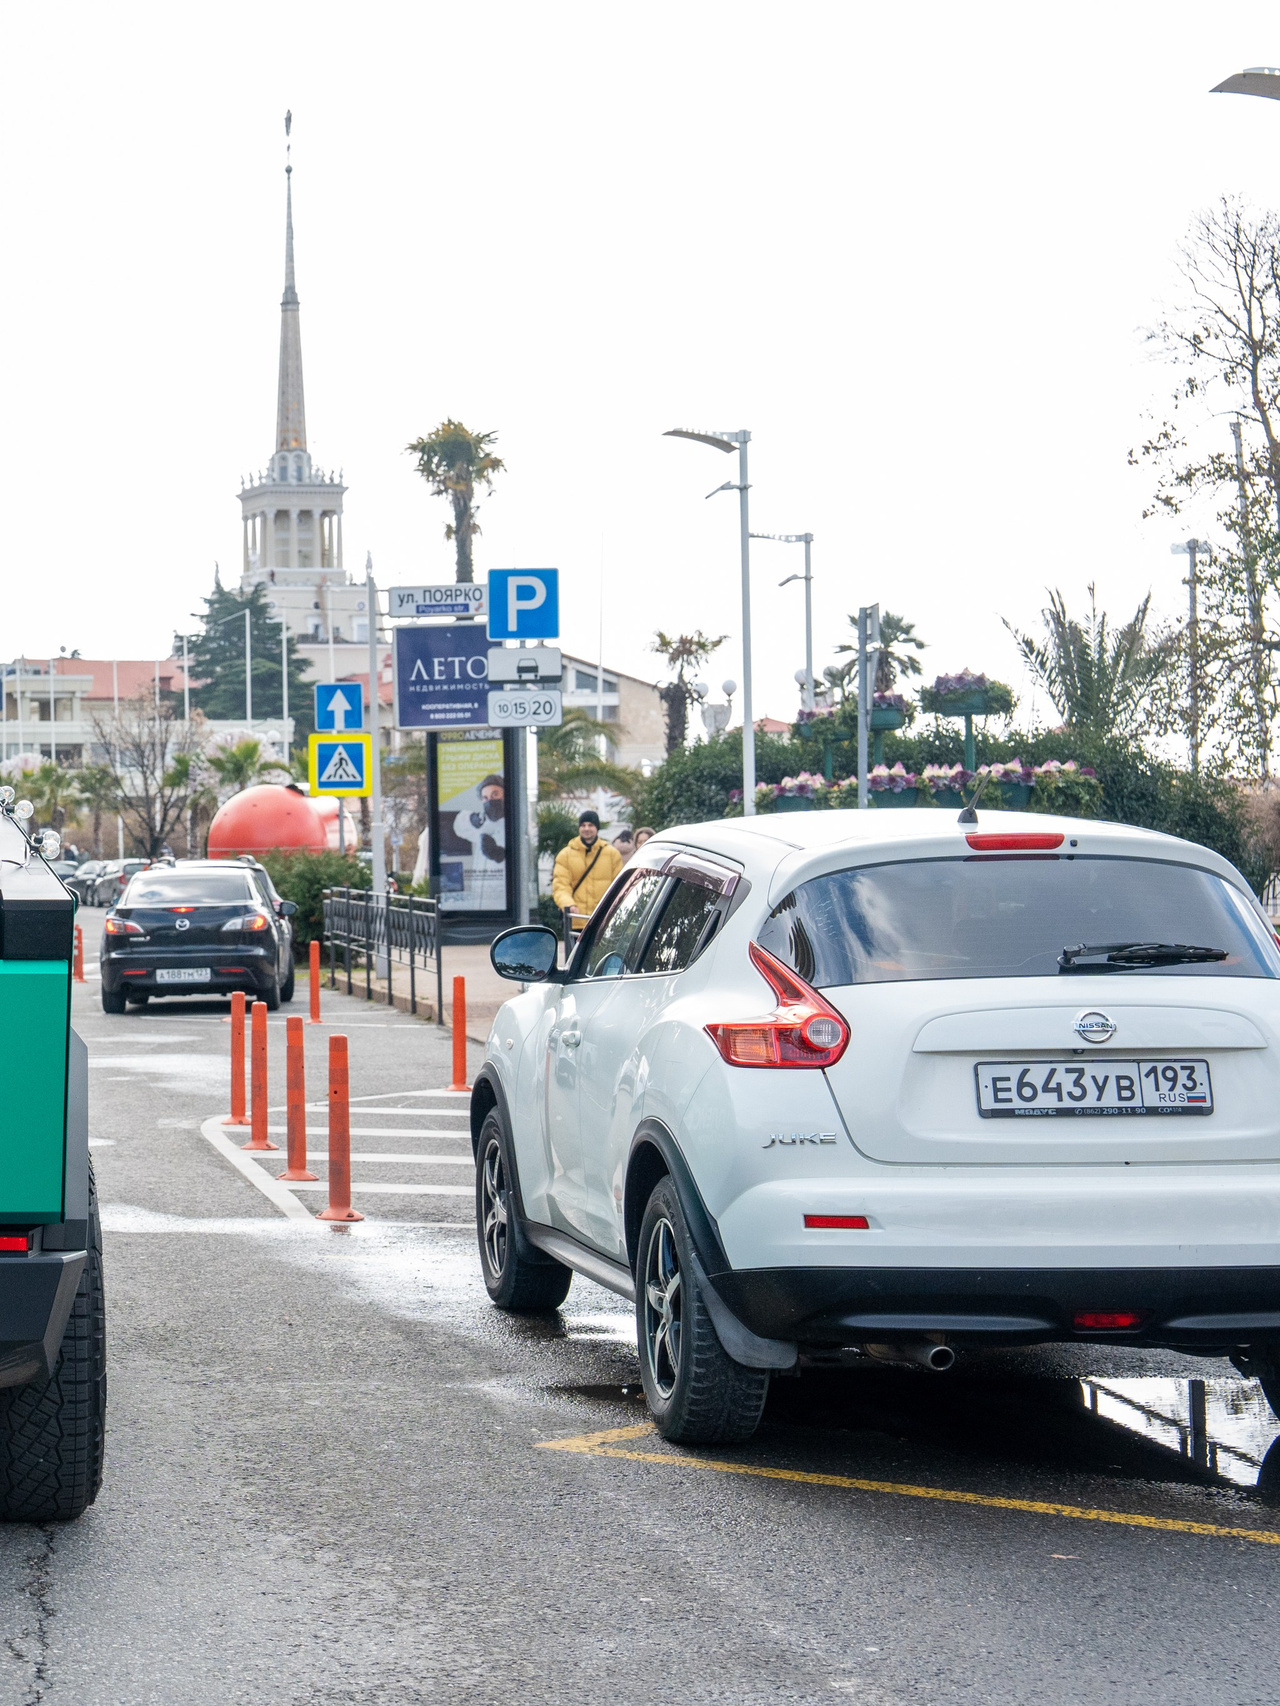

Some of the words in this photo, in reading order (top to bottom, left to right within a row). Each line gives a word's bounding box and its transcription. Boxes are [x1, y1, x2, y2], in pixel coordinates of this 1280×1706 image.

[397, 593, 419, 608] ул.
[422, 587, 483, 603] ПОЯРКО
[507, 575, 547, 632] P
[409, 655, 488, 681] ЛЕТО
[408, 682, 490, 692] НЕДВИЖИМОСТЬ
[498, 703, 509, 714] 10
[513, 702, 527, 715] 15
[531, 700, 553, 716] 20
[991, 1066, 1137, 1104] Е643УВ
[1143, 1065, 1199, 1093] 193
[1158, 1092, 1187, 1103] RUS
[761, 1132, 838, 1149] JUKE
